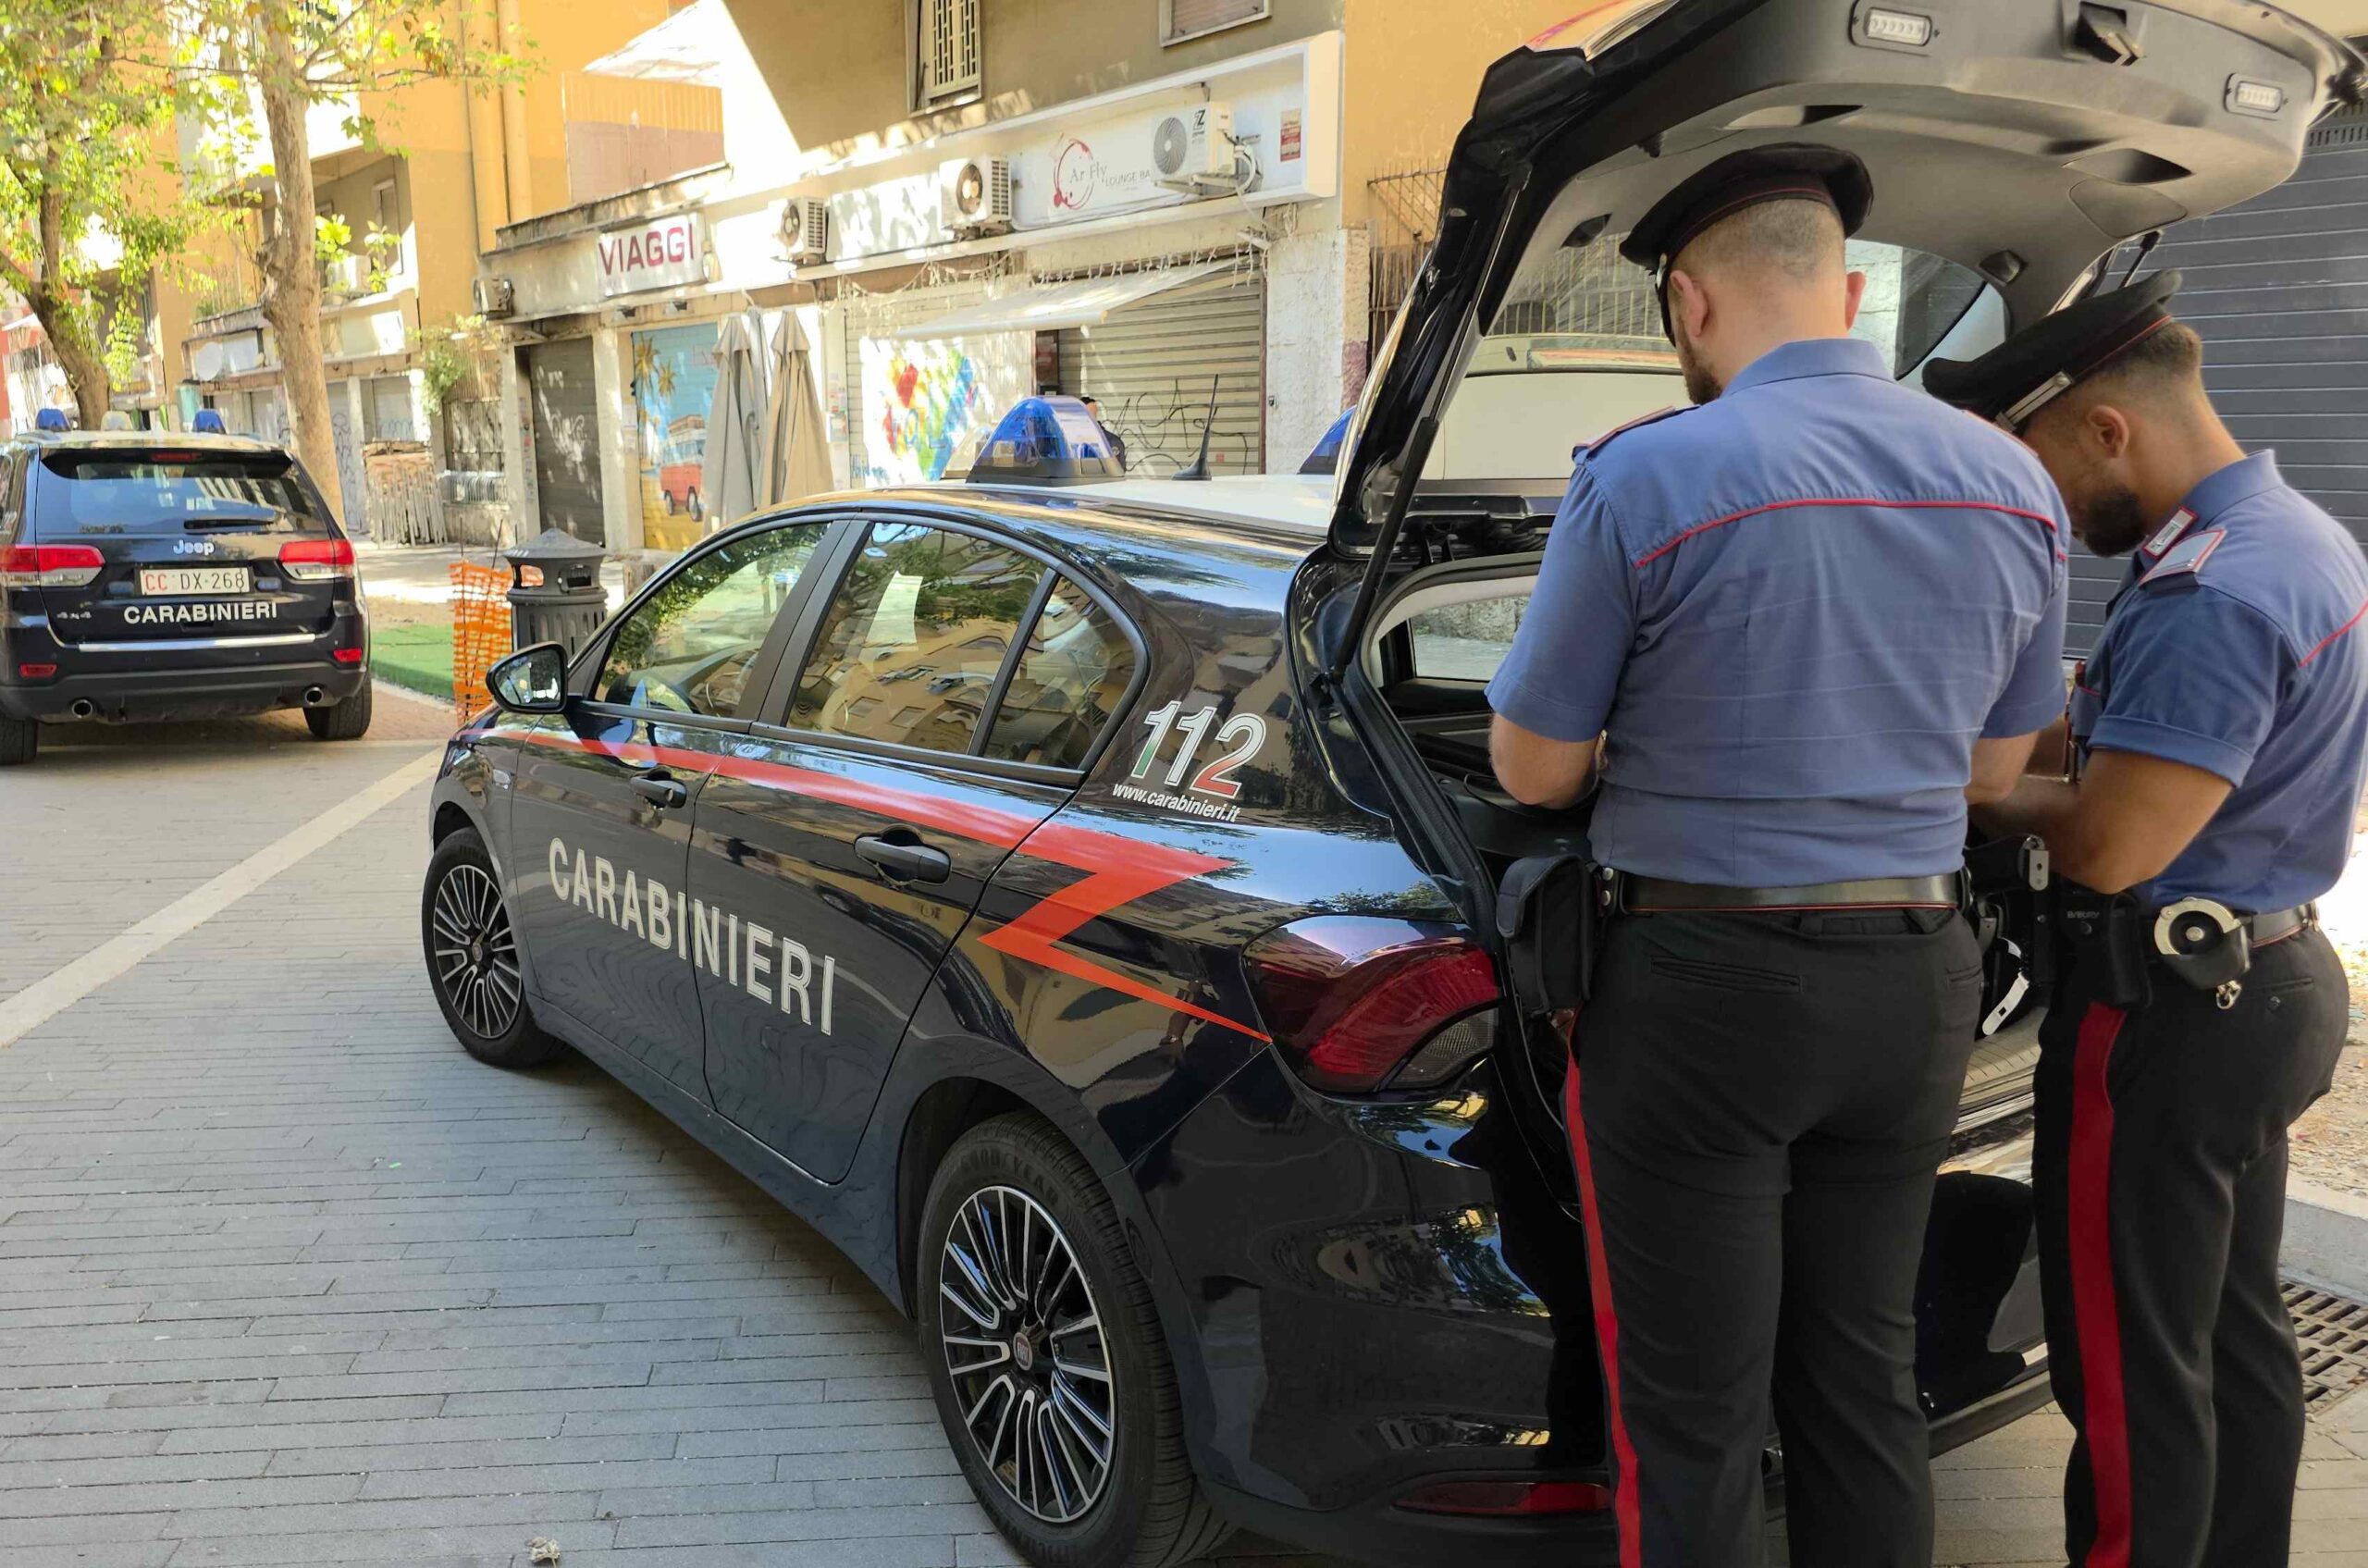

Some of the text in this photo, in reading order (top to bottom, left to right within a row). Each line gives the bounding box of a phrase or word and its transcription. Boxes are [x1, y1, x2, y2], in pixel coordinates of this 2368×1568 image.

[1069, 161, 1107, 184] Ar Fly
[1104, 168, 1152, 187] LOUNGE BA
[598, 223, 694, 276] VIAGGI
[173, 540, 215, 556] Jeep
[145, 572, 245, 592] CC DX 268
[124, 601, 278, 625] CARABINIERI
[1130, 700, 1267, 799] 112
[1112, 782, 1242, 823] www.carabinieri.it
[549, 837, 835, 1036] CARABINIERI
